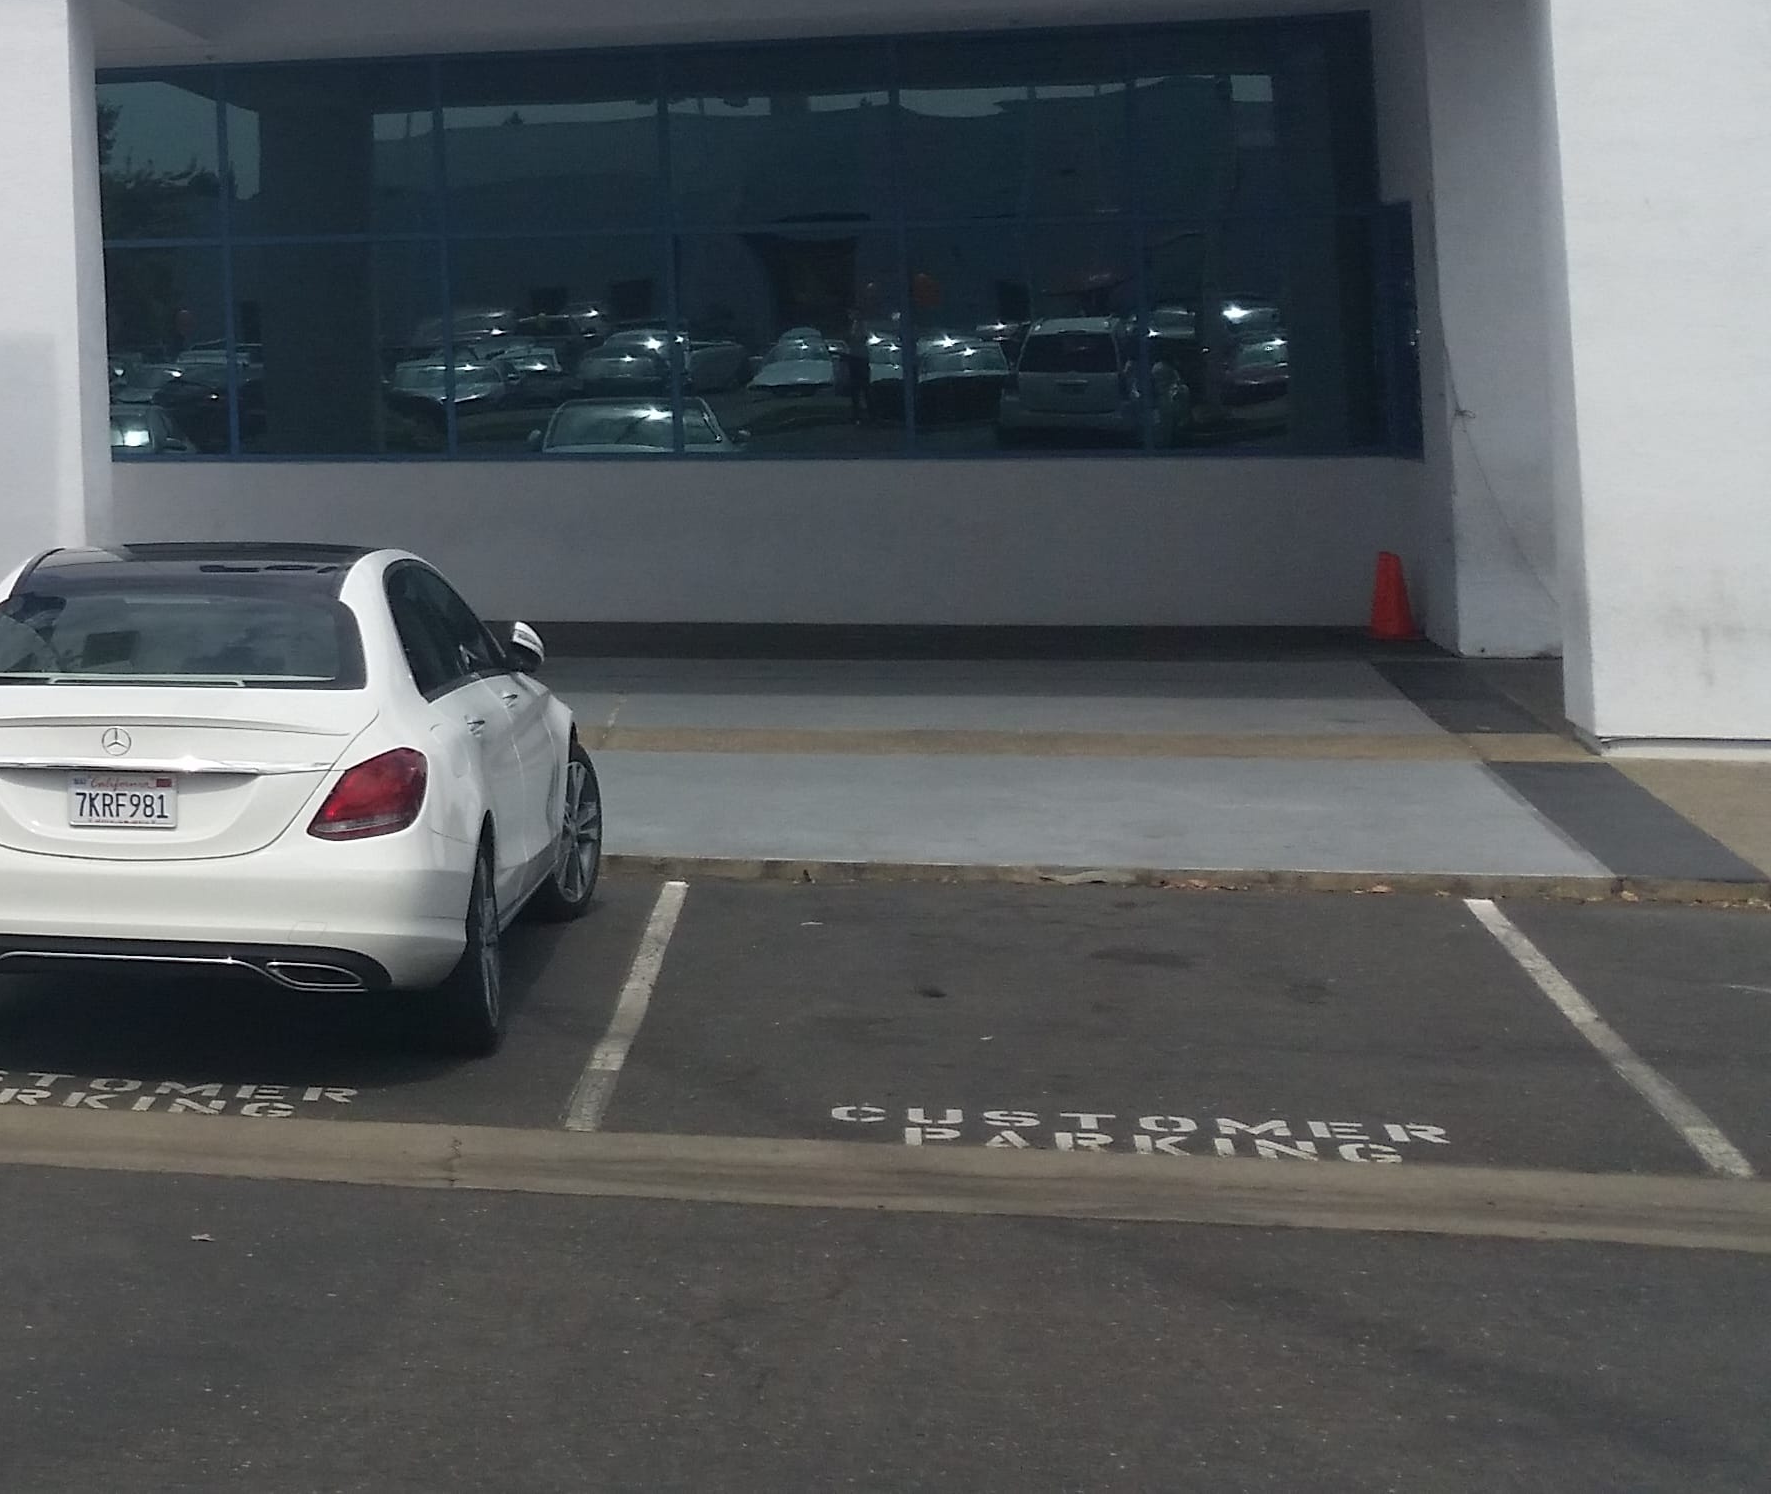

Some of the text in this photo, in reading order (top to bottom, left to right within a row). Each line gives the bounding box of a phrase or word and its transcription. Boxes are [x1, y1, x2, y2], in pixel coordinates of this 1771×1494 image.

[91, 778, 153, 791] California
[75, 792, 169, 818] 7KRF981
[831, 1105, 1452, 1145] CUSTOMER
[905, 1127, 1403, 1164] PARKING
